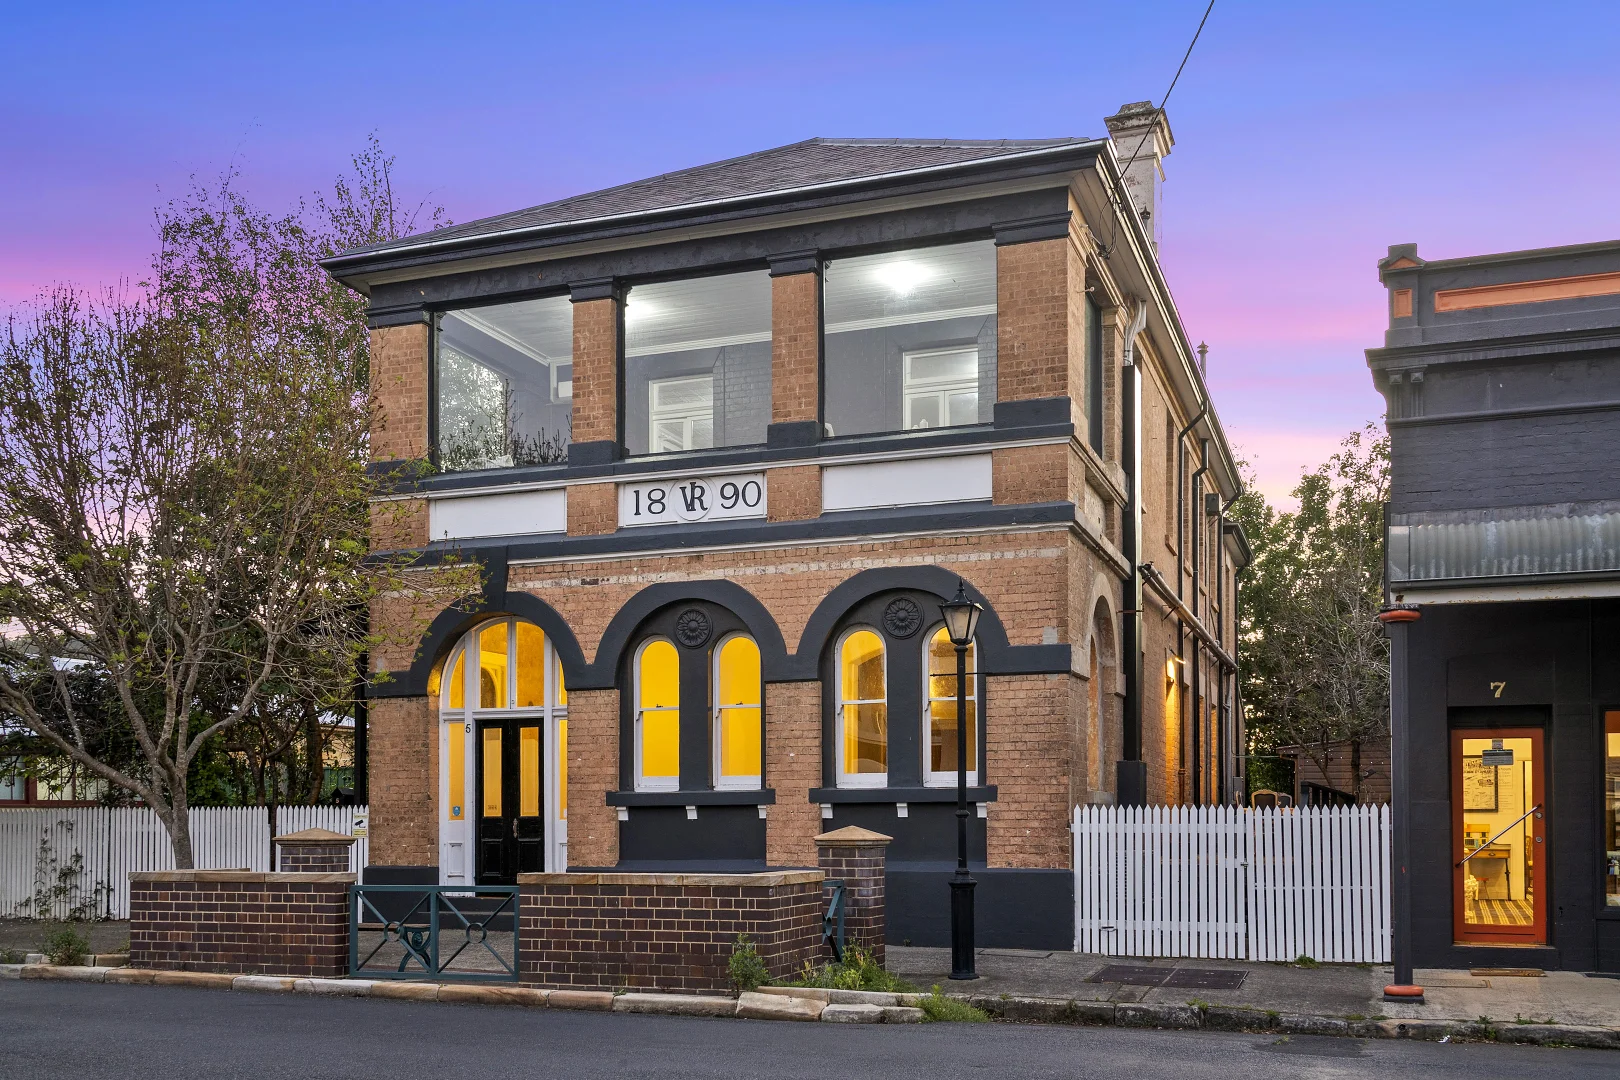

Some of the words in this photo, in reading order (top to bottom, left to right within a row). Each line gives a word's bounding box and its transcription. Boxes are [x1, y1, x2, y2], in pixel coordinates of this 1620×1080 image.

[633, 488, 666, 516] 18
[719, 480, 762, 510] 90
[1490, 681, 1506, 698] 7
[465, 723, 472, 734] 5
